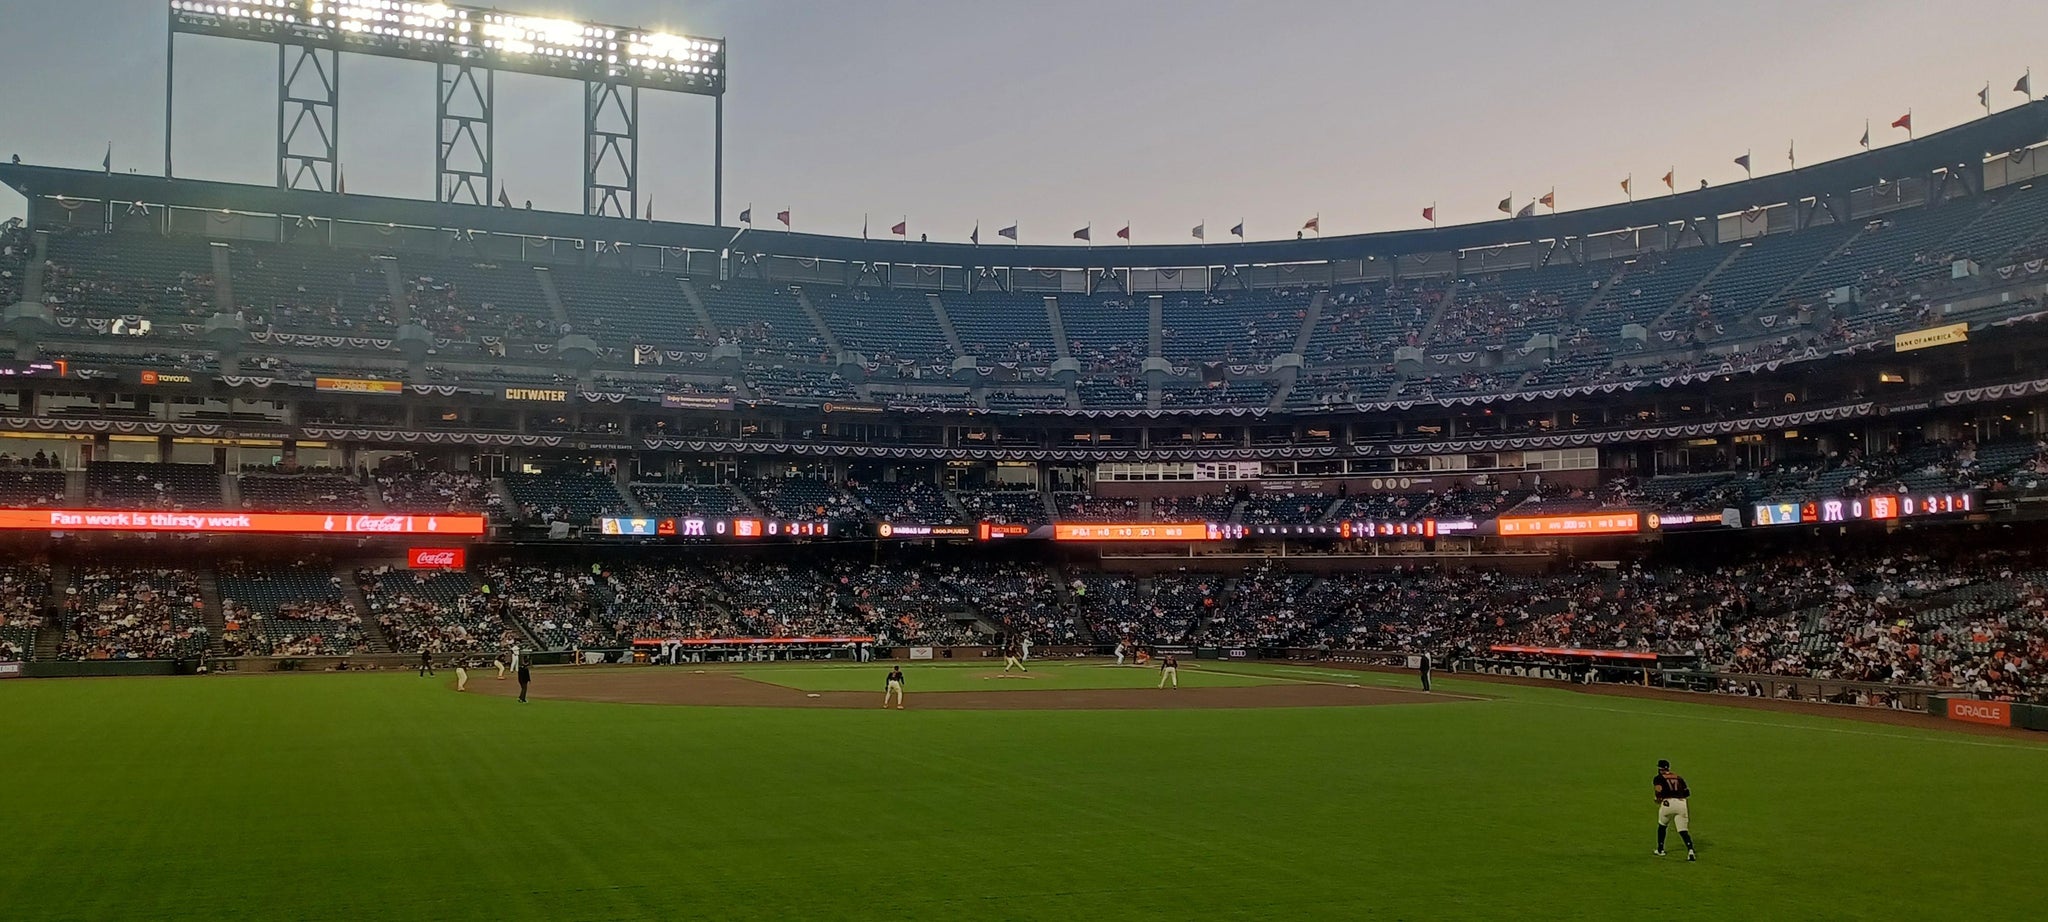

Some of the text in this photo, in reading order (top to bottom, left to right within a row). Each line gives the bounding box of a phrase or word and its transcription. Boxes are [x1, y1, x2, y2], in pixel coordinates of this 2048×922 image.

[1896, 340, 1913, 348] BANK
[1923, 333, 1952, 343] AMERICA
[158, 375, 190, 383] TOYOTA
[505, 388, 566, 401] CUTWATER
[1809, 503, 1816, 515] 3
[1853, 501, 1862, 518] 0
[1904, 498, 1914, 515] 0
[1928, 497, 1937, 513] 3
[1939, 501, 1946, 510] S
[1946, 496, 1953, 512] 1
[1963, 494, 1970, 511] 1
[50, 512, 250, 529] Fan work is thirsty work
[356, 516, 405, 532] Coca-Cola
[666, 520, 673, 529] 3
[716, 522, 725, 534] 0
[768, 522, 777, 534] 0
[791, 522, 799, 535] 3
[807, 522, 814, 535] 1
[823, 522, 828, 535] 1
[1515, 522, 1520, 531] 1
[1535, 521, 1541, 530] 0
[1608, 519, 1613, 528] 0
[1627, 518, 1633, 527] 0
[1125, 528, 1132, 536] 0
[1176, 528, 1182, 536] 0
[416, 552, 454, 565] Coca-Cola
[1955, 704, 2000, 719] ORACLE
[1666, 779, 1678, 791] 17
